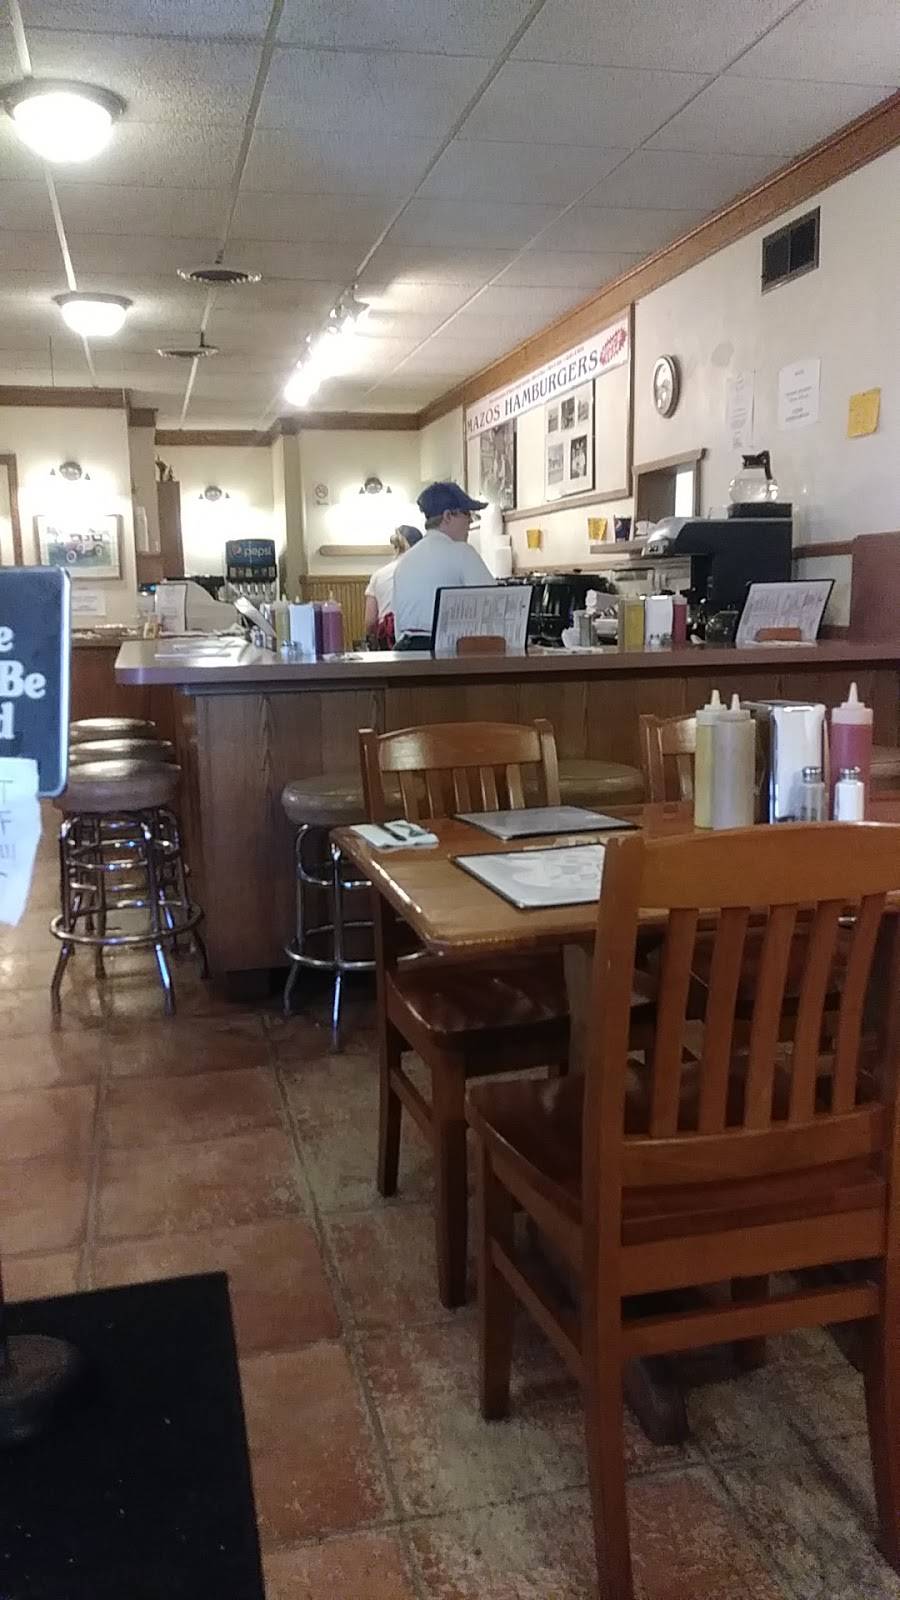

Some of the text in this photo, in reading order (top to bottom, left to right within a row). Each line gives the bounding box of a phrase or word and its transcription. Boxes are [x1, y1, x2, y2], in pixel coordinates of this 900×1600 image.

[505, 349, 598, 416] HAMBURGERS
[244, 546, 272, 558] pepsi
[0, 660, 46, 699] Be
